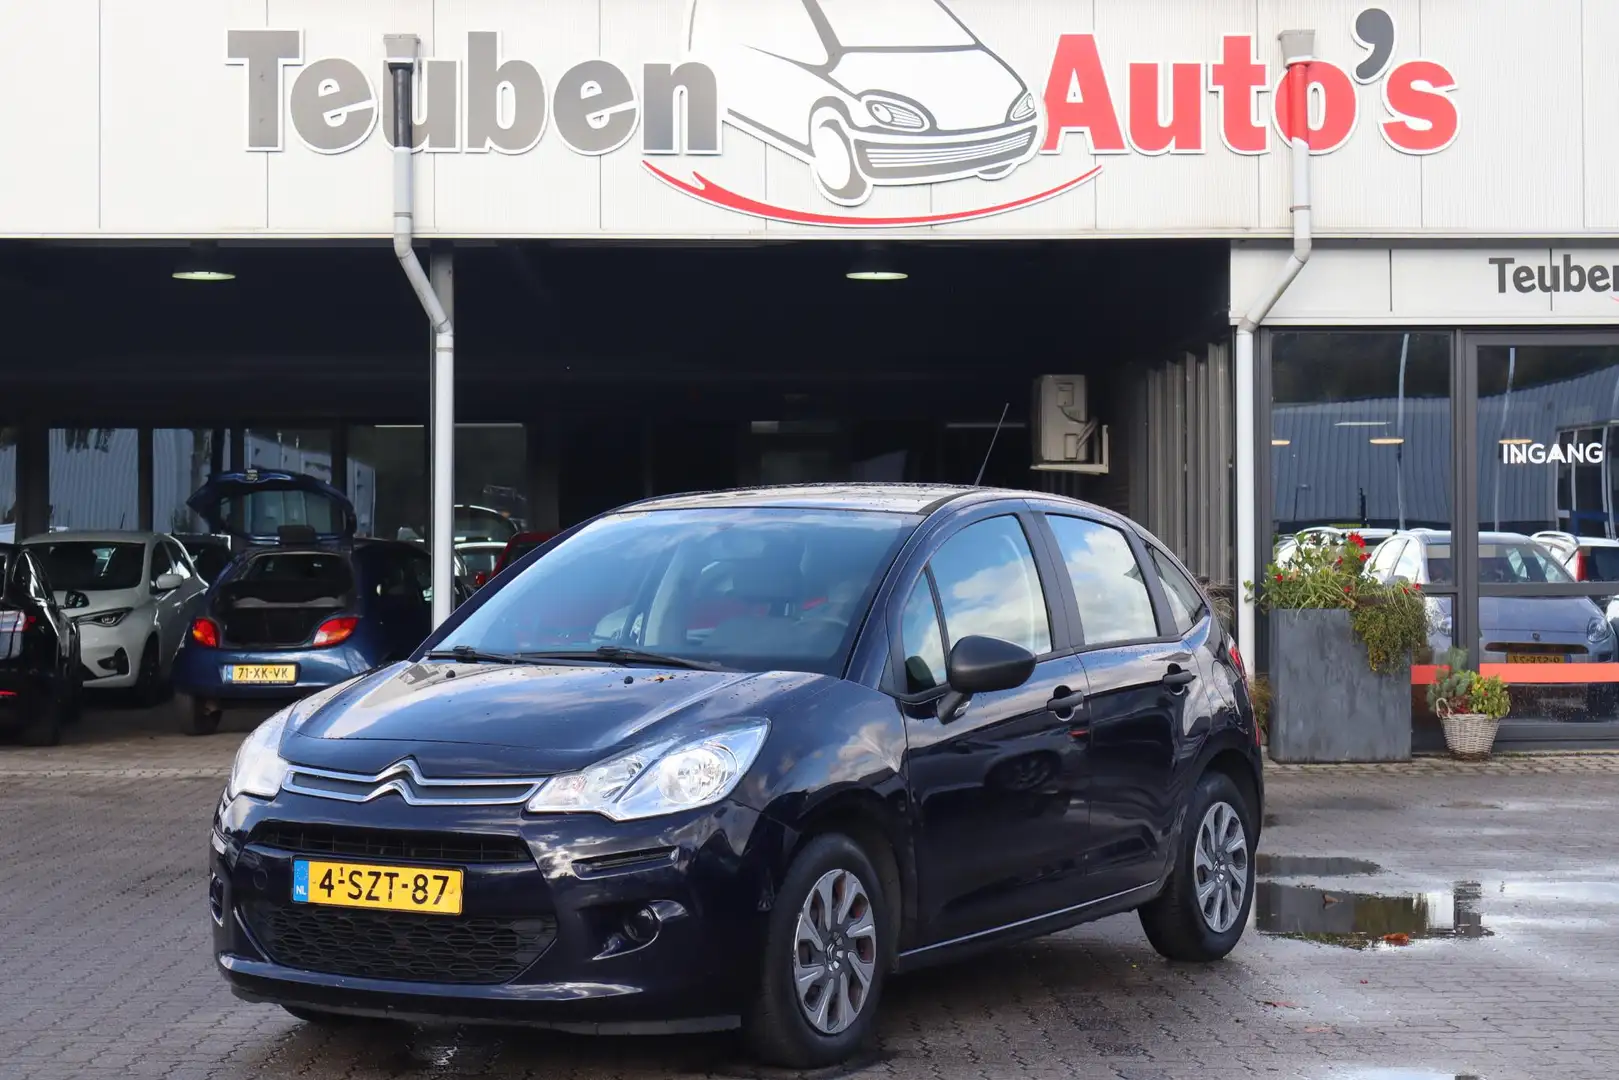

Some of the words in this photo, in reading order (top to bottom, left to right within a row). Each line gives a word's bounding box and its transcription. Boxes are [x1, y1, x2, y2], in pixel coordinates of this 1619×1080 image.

[226, 29, 718, 155] Teuben
[1040, 7, 1460, 154] Auto's
[1503, 443, 1604, 464] INGANG
[238, 667, 288, 679] 71-XK-VK
[296, 885, 306, 896] NL
